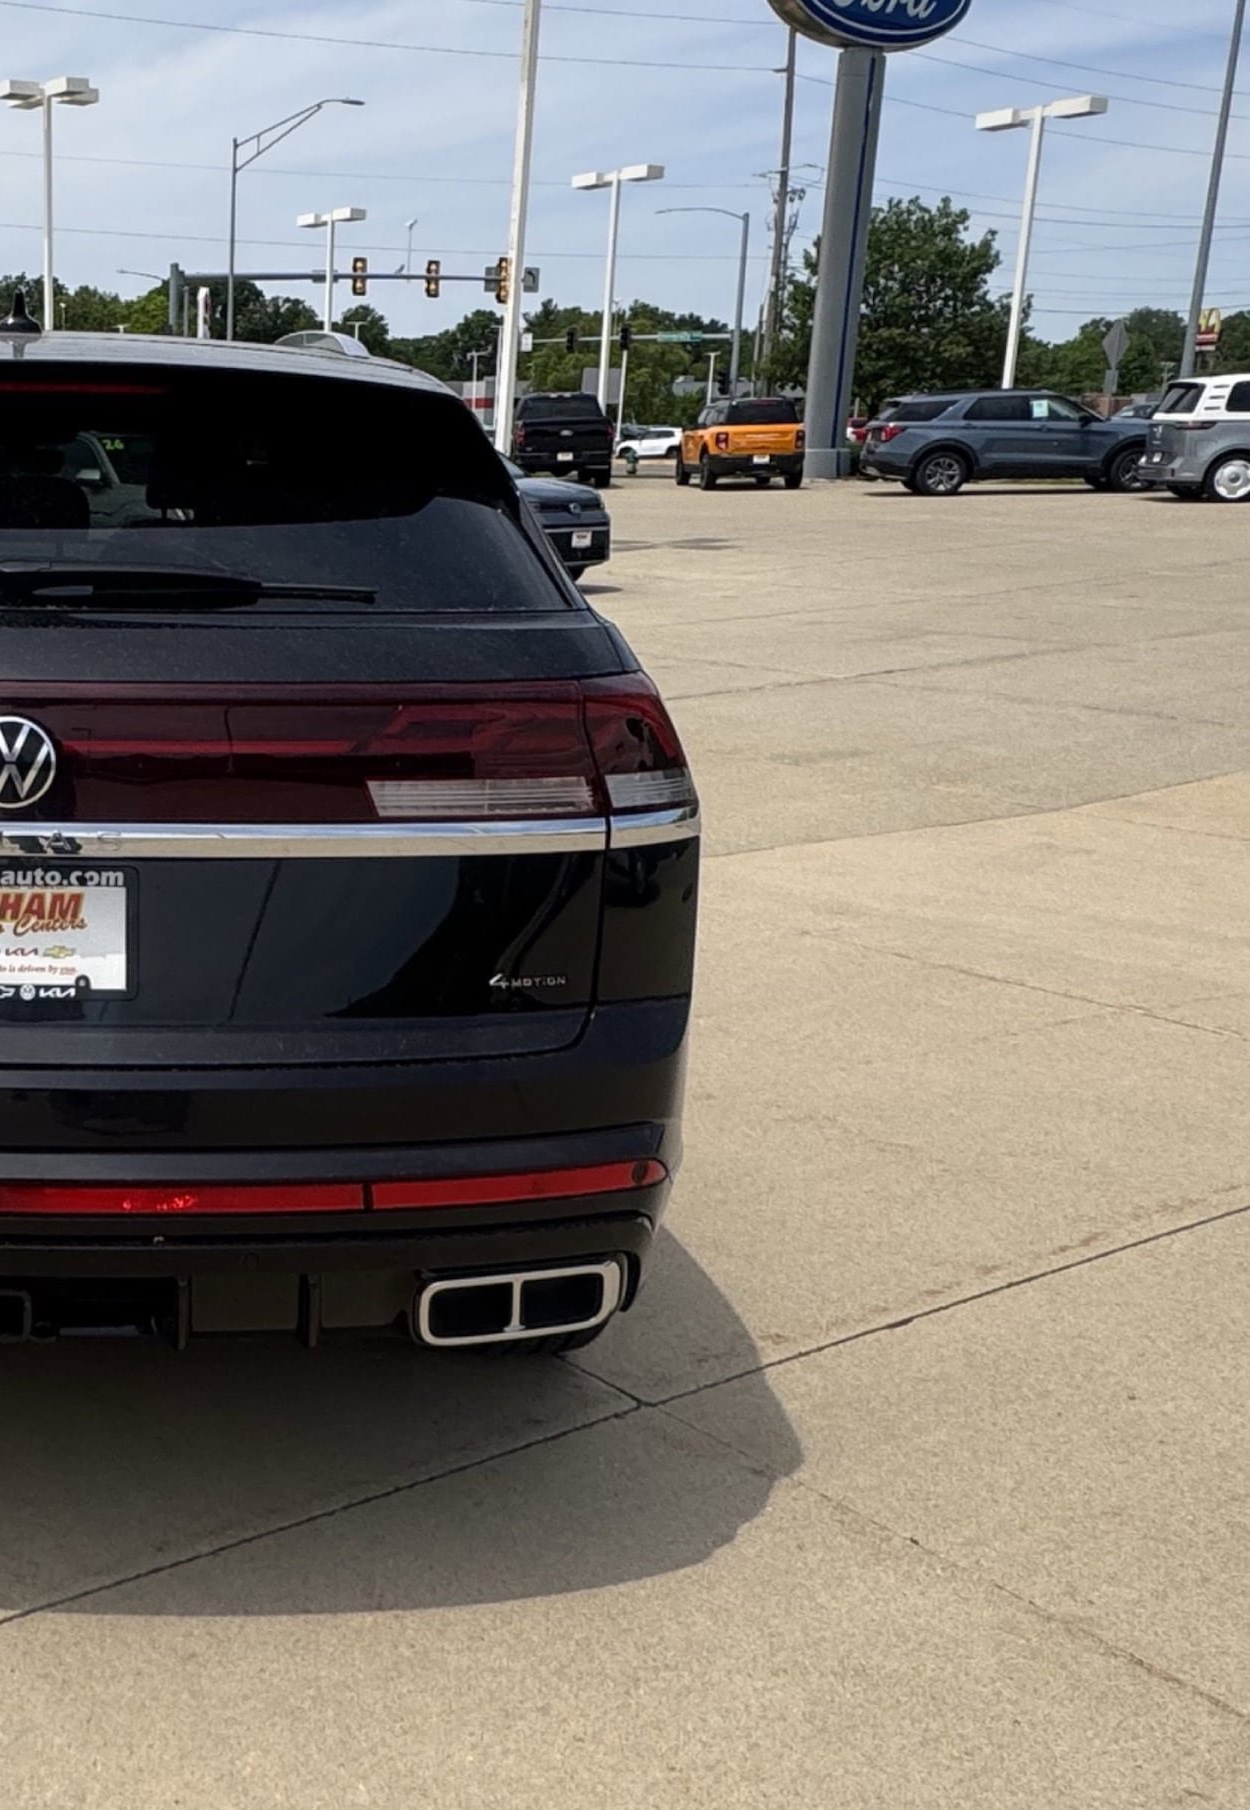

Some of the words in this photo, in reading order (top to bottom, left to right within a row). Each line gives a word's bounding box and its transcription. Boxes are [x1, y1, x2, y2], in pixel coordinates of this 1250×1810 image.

[102, 439, 124, 450] 26
[13, 915, 88, 937] Centers
[5, 947, 38, 956] KIA
[17, 964, 46, 973] driven
[48, 964, 58, 975] by
[489, 973, 567, 989] 4MOTION
[39, 987, 76, 998] KIA
